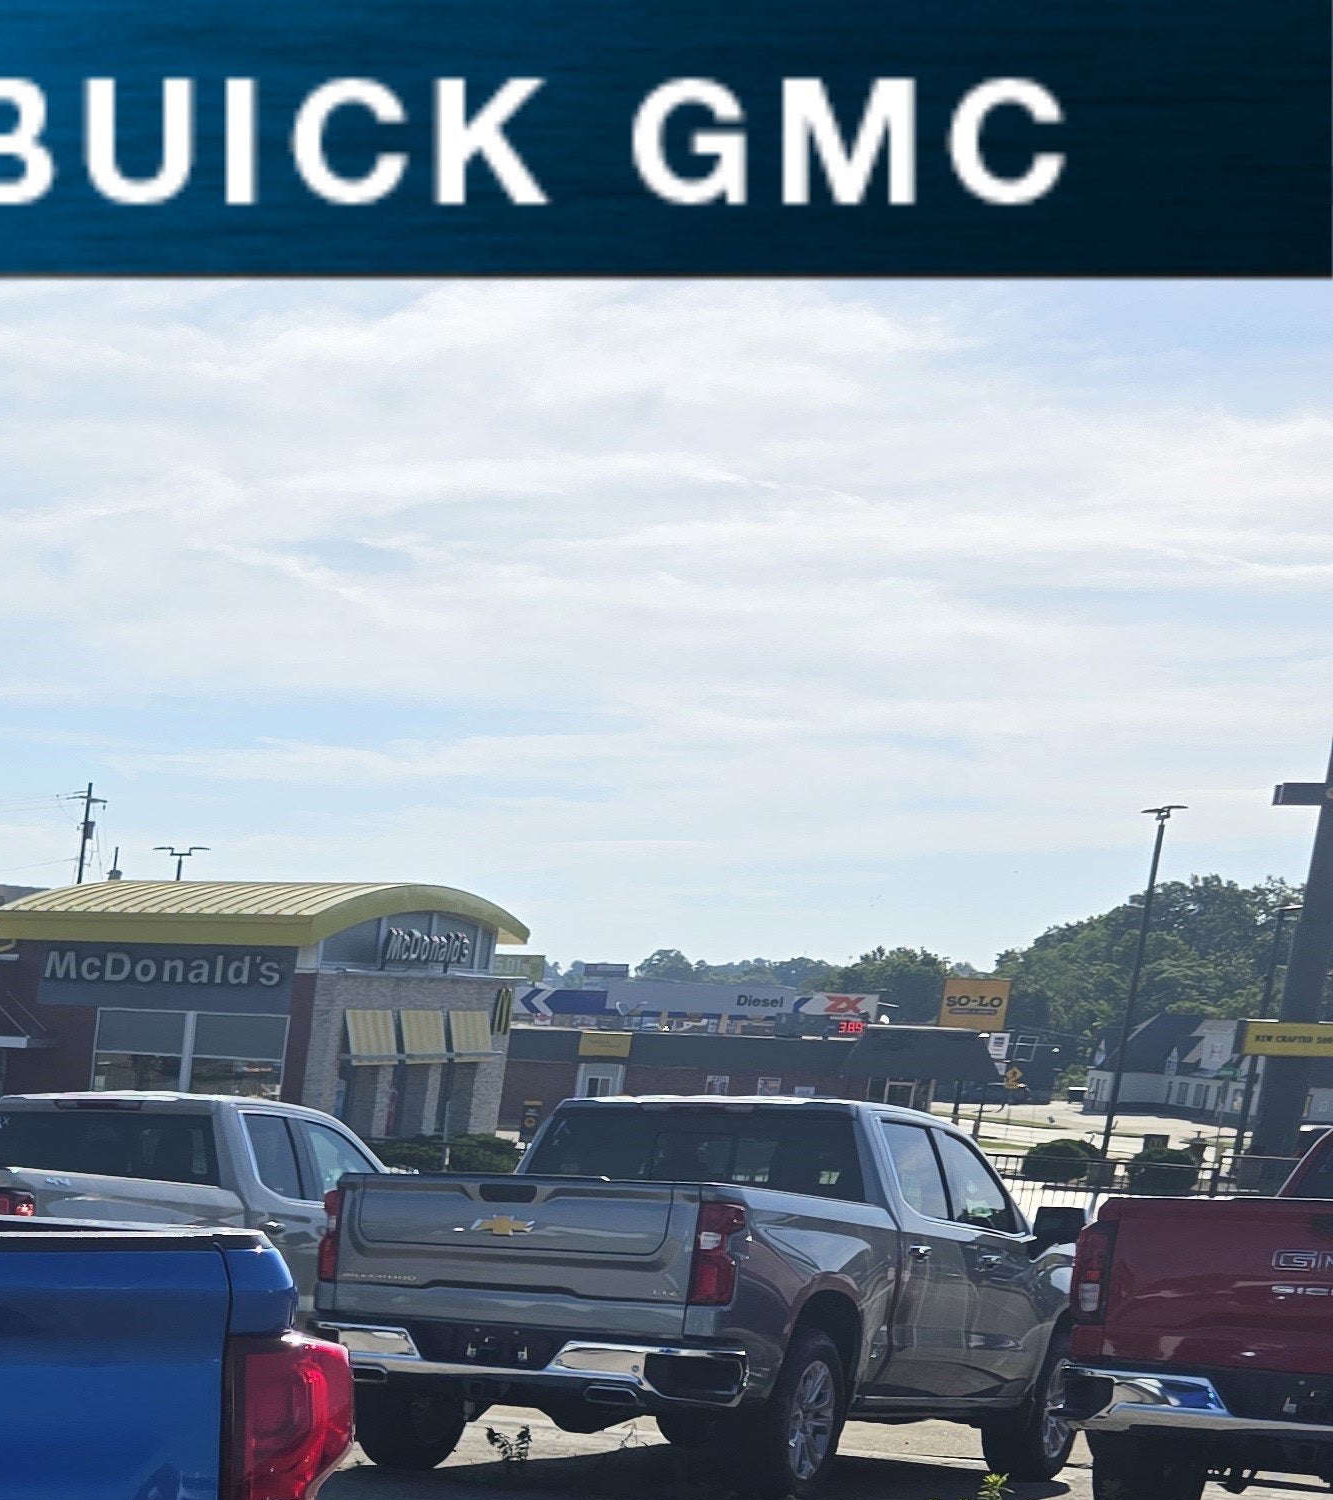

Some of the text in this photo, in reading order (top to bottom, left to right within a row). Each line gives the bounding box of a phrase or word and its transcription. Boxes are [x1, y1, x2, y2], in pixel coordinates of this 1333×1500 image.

[44, 950, 281, 986] McDonald's
[736, 994, 784, 1008] Diesel
[823, 995, 866, 1013] ZX
[946, 995, 1003, 1008] SO-LO
